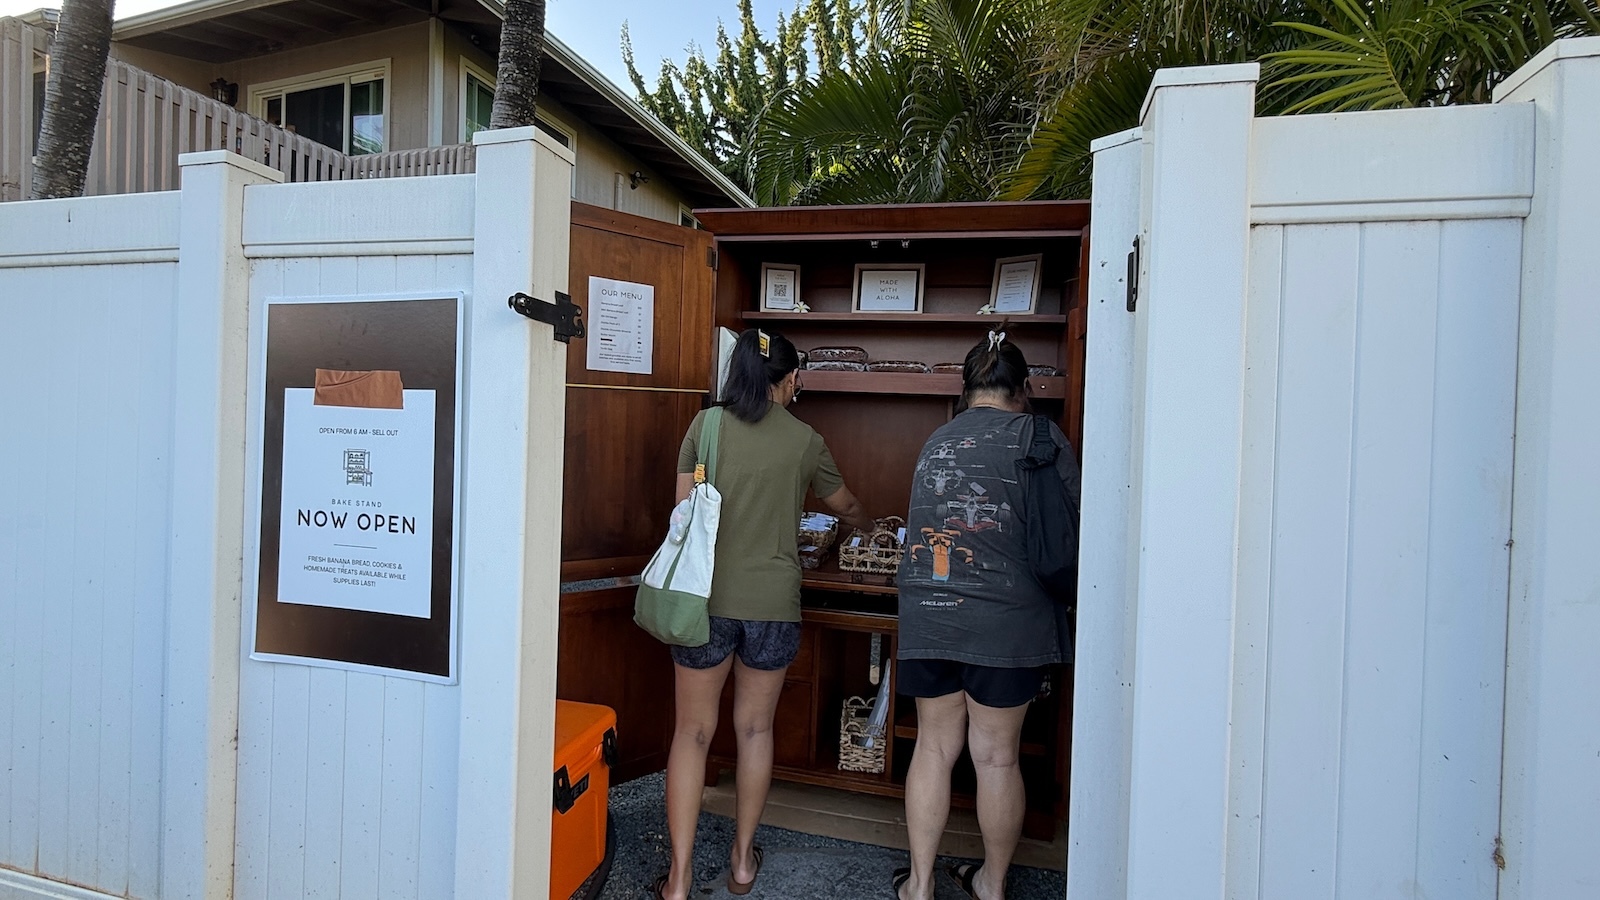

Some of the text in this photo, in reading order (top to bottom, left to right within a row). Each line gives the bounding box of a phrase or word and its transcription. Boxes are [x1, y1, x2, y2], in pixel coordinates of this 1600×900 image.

[601, 288, 643, 301] OUR MENU
[336, 427, 353, 435] FROM
[331, 498, 382, 508] BAKE STAND
[297, 508, 415, 535] NOW OPEN
[307, 555, 326, 563] FRESH
[327, 556, 351, 565] BANANA
[351, 559, 371, 567] BREAD,
[371, 561, 397, 570] COOKIES
[303, 565, 406, 581] HOMEMADE TREATS AVAILABLE WHILE
[333, 577, 360, 585] SUPPLIES
